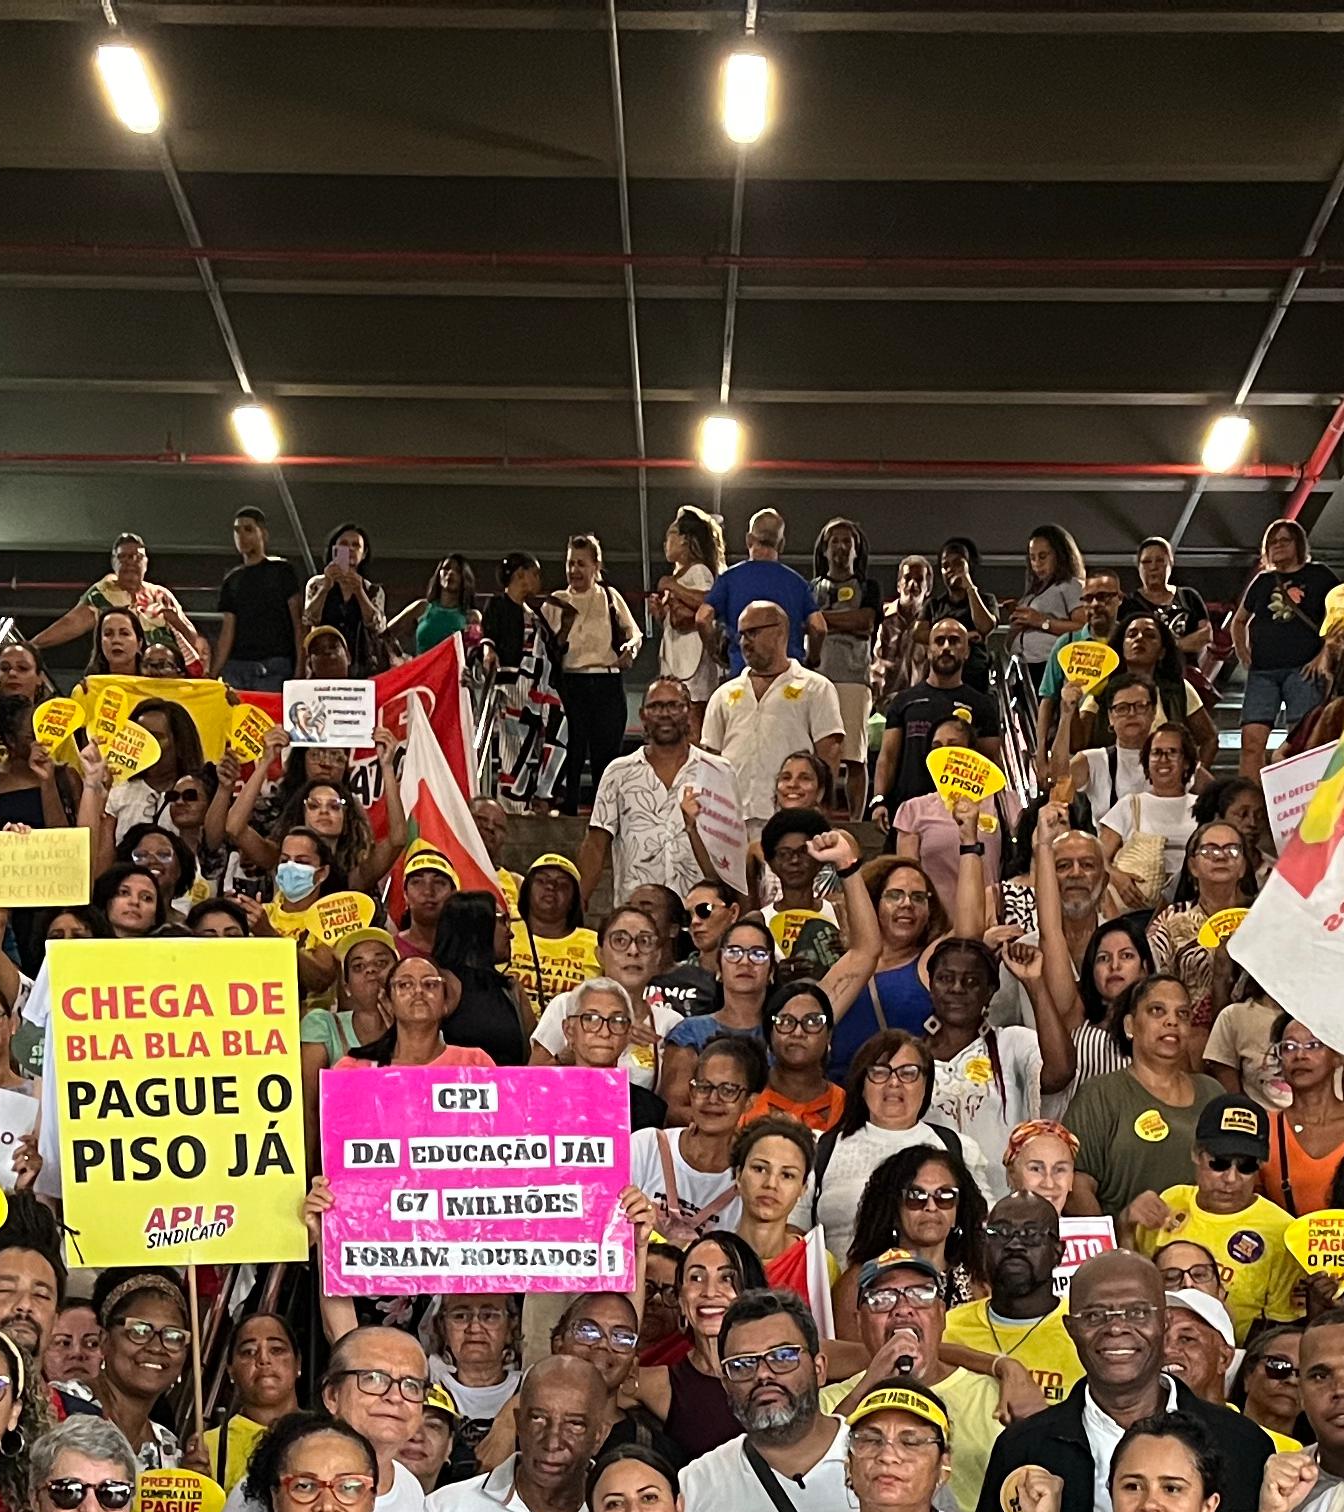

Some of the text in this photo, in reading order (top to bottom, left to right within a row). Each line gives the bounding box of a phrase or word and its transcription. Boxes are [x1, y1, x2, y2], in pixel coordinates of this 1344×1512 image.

[940, 775, 948, 784] O
[943, 764, 985, 786] PAGUE
[62, 982, 285, 1021] CHEGA DE
[67, 1028, 288, 1061] BLA BLA BLA
[67, 1074, 293, 1120] PAGUE O
[437, 1087, 490, 1111] CPI
[73, 1120, 295, 1183] PISO JÁ
[351, 1137, 606, 1167] DA EDUCAÇÃO JÁ!
[397, 1189, 578, 1216] 67 MILHÕES
[145, 1205, 235, 1233] APLB
[146, 1222, 226, 1248] SINDICATO
[344, 1245, 597, 1267] FORAM ROUBADOS
[1308, 1255, 1317, 1266] O
